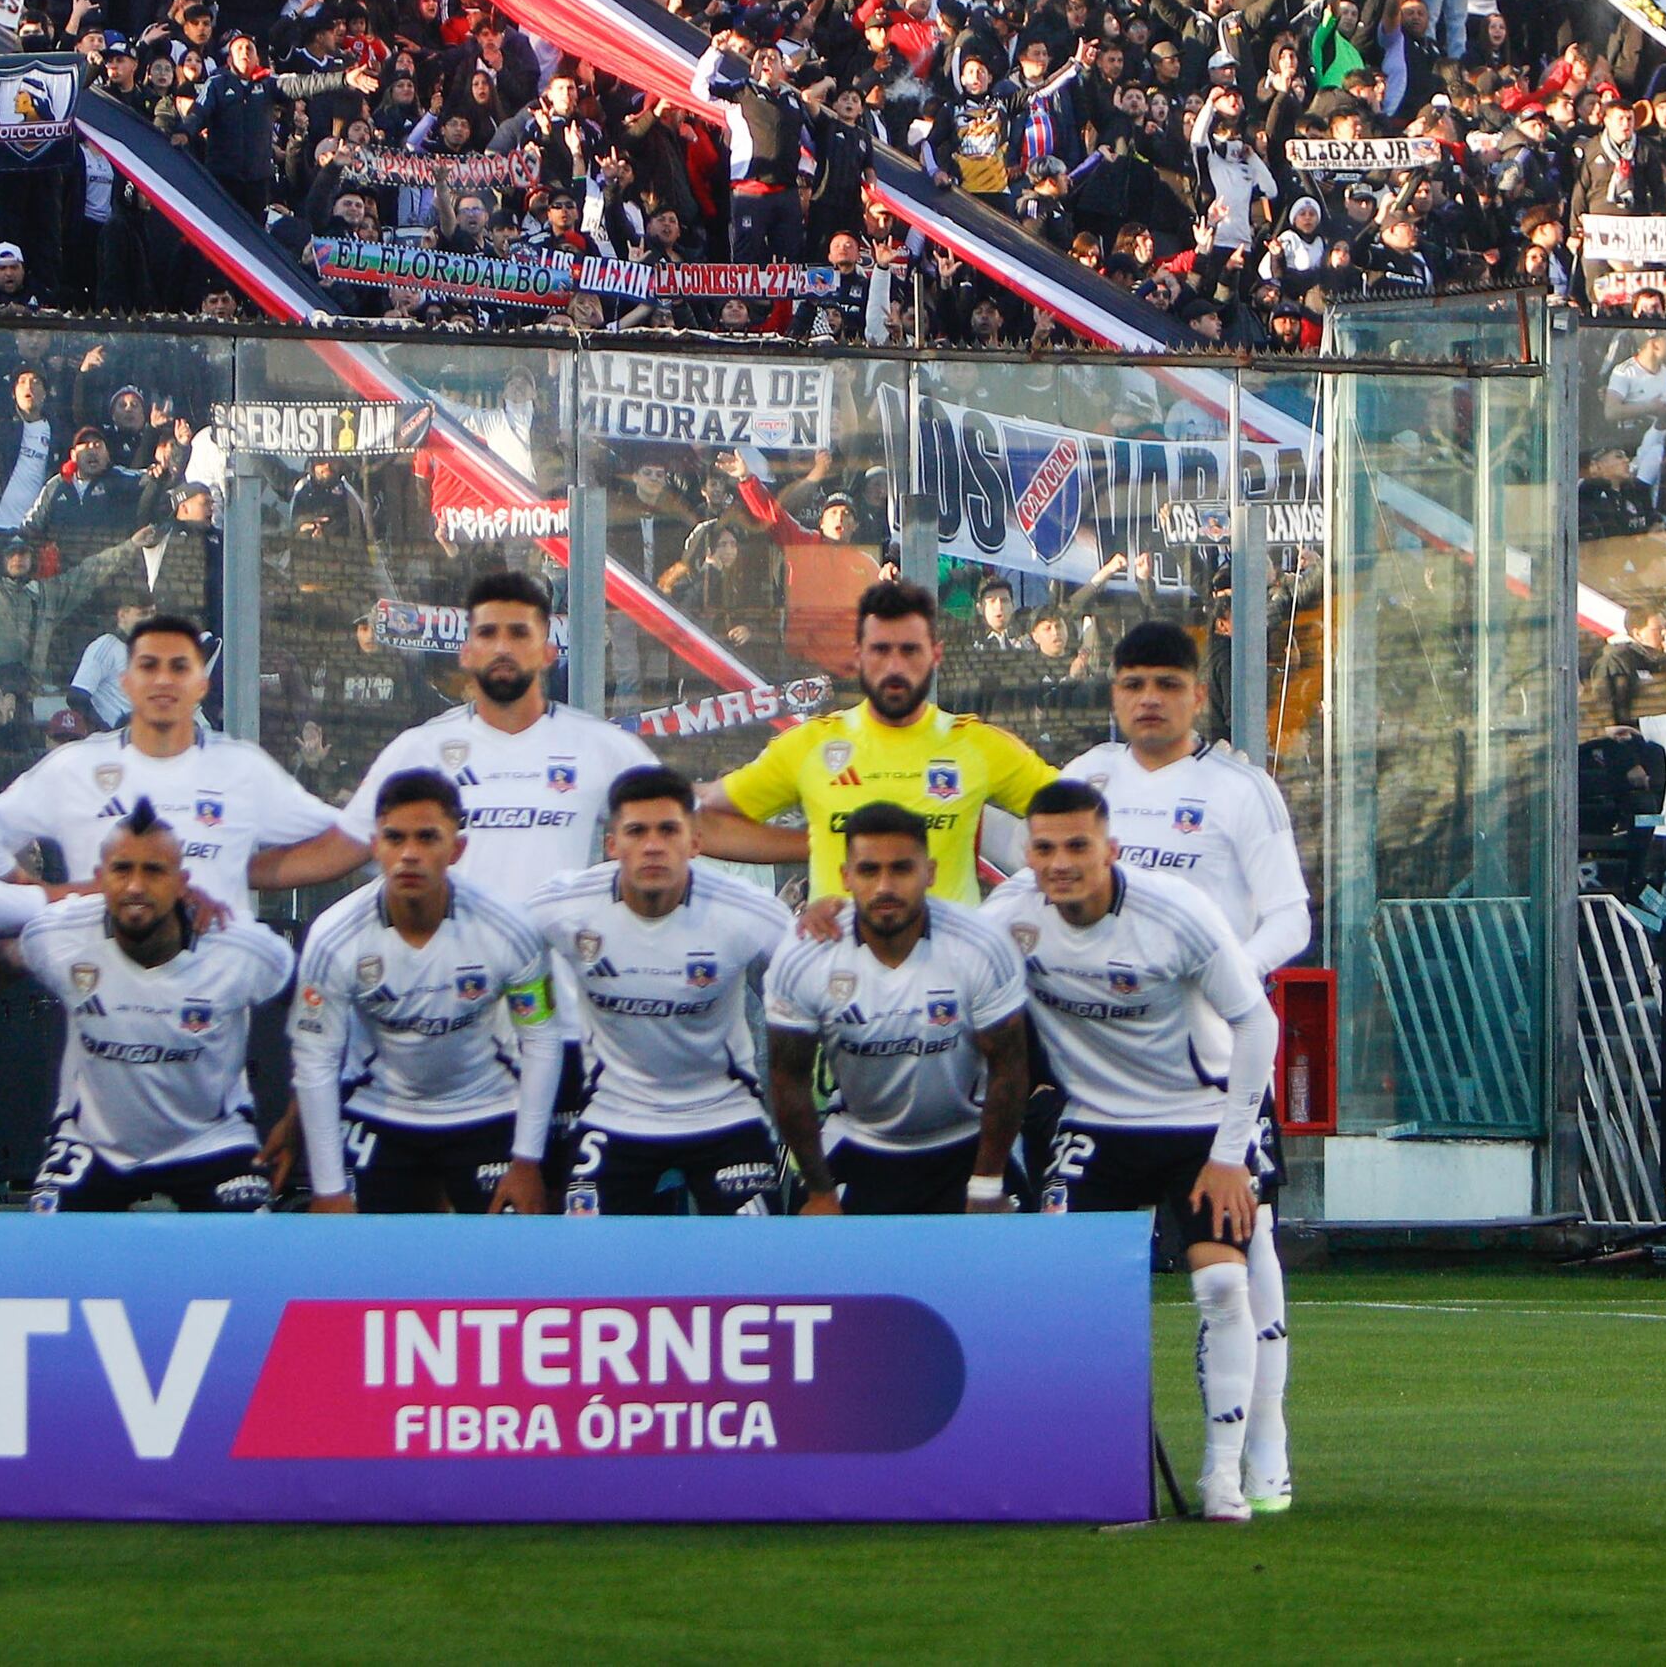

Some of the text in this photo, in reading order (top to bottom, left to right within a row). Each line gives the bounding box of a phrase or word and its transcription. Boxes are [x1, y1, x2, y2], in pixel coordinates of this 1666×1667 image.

[1303, 139, 1379, 162] LGXA
[334, 239, 371, 271] EL
[655, 263, 680, 297] LA
[679, 262, 762, 297] CONKISTA
[579, 351, 821, 408] ALEGRIA DE
[231, 404, 397, 452] SEBASTAN
[617, 399, 821, 447] CORAZN
[1170, 506, 1199, 546] LOS
[393, 636, 440, 650] FAMILIA
[39, 1138, 95, 1187] 23
[572, 1129, 609, 1176] 5
[713, 1161, 778, 1181] PHILIPS
[361, 1301, 833, 1393] INTERNET
[391, 1391, 779, 1458] FIBRA ÓPTICA
